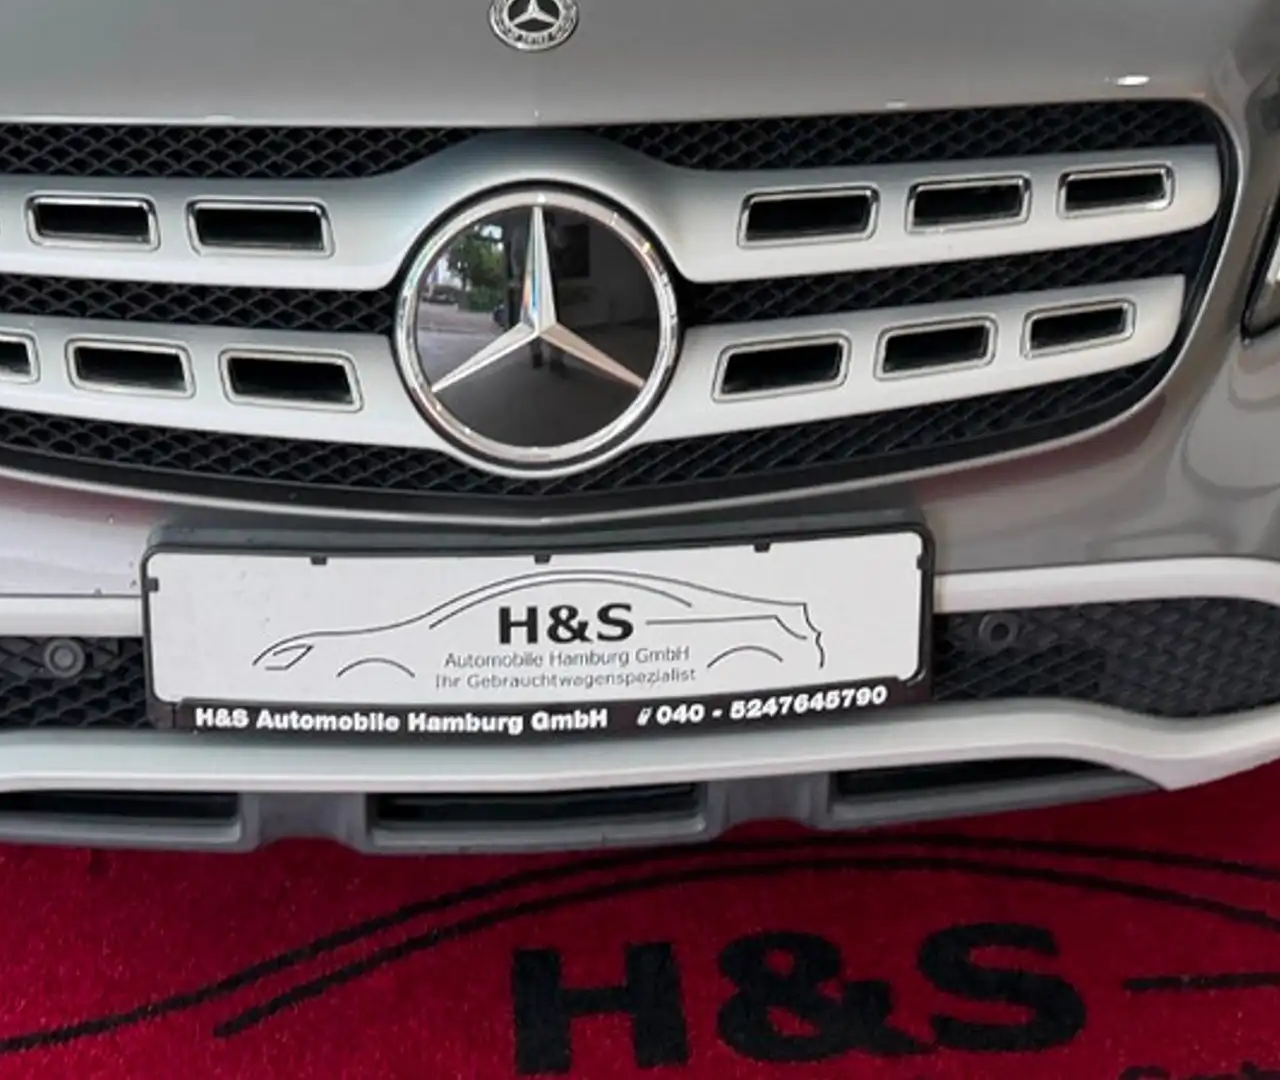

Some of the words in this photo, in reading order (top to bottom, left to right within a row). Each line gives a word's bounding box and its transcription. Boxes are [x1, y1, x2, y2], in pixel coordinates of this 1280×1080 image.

[498, 602, 635, 645] H&S
[435, 672, 461, 688] Ihr
[466, 668, 697, 689] Gebrauchtwagenspezialist
[444, 651, 544, 669] Automobile
[549, 649, 630, 668] Hamburg
[635, 645, 691, 664] GmbH
[195, 707, 249, 729] H&S
[256, 709, 400, 731] Automobile
[407, 712, 524, 735] Hamburg
[531, 708, 608, 731] GmbH
[655, 703, 705, 725] 040
[729, 685, 888, 719] 5247645790
[511, 923, 1087, 1077] H&S
